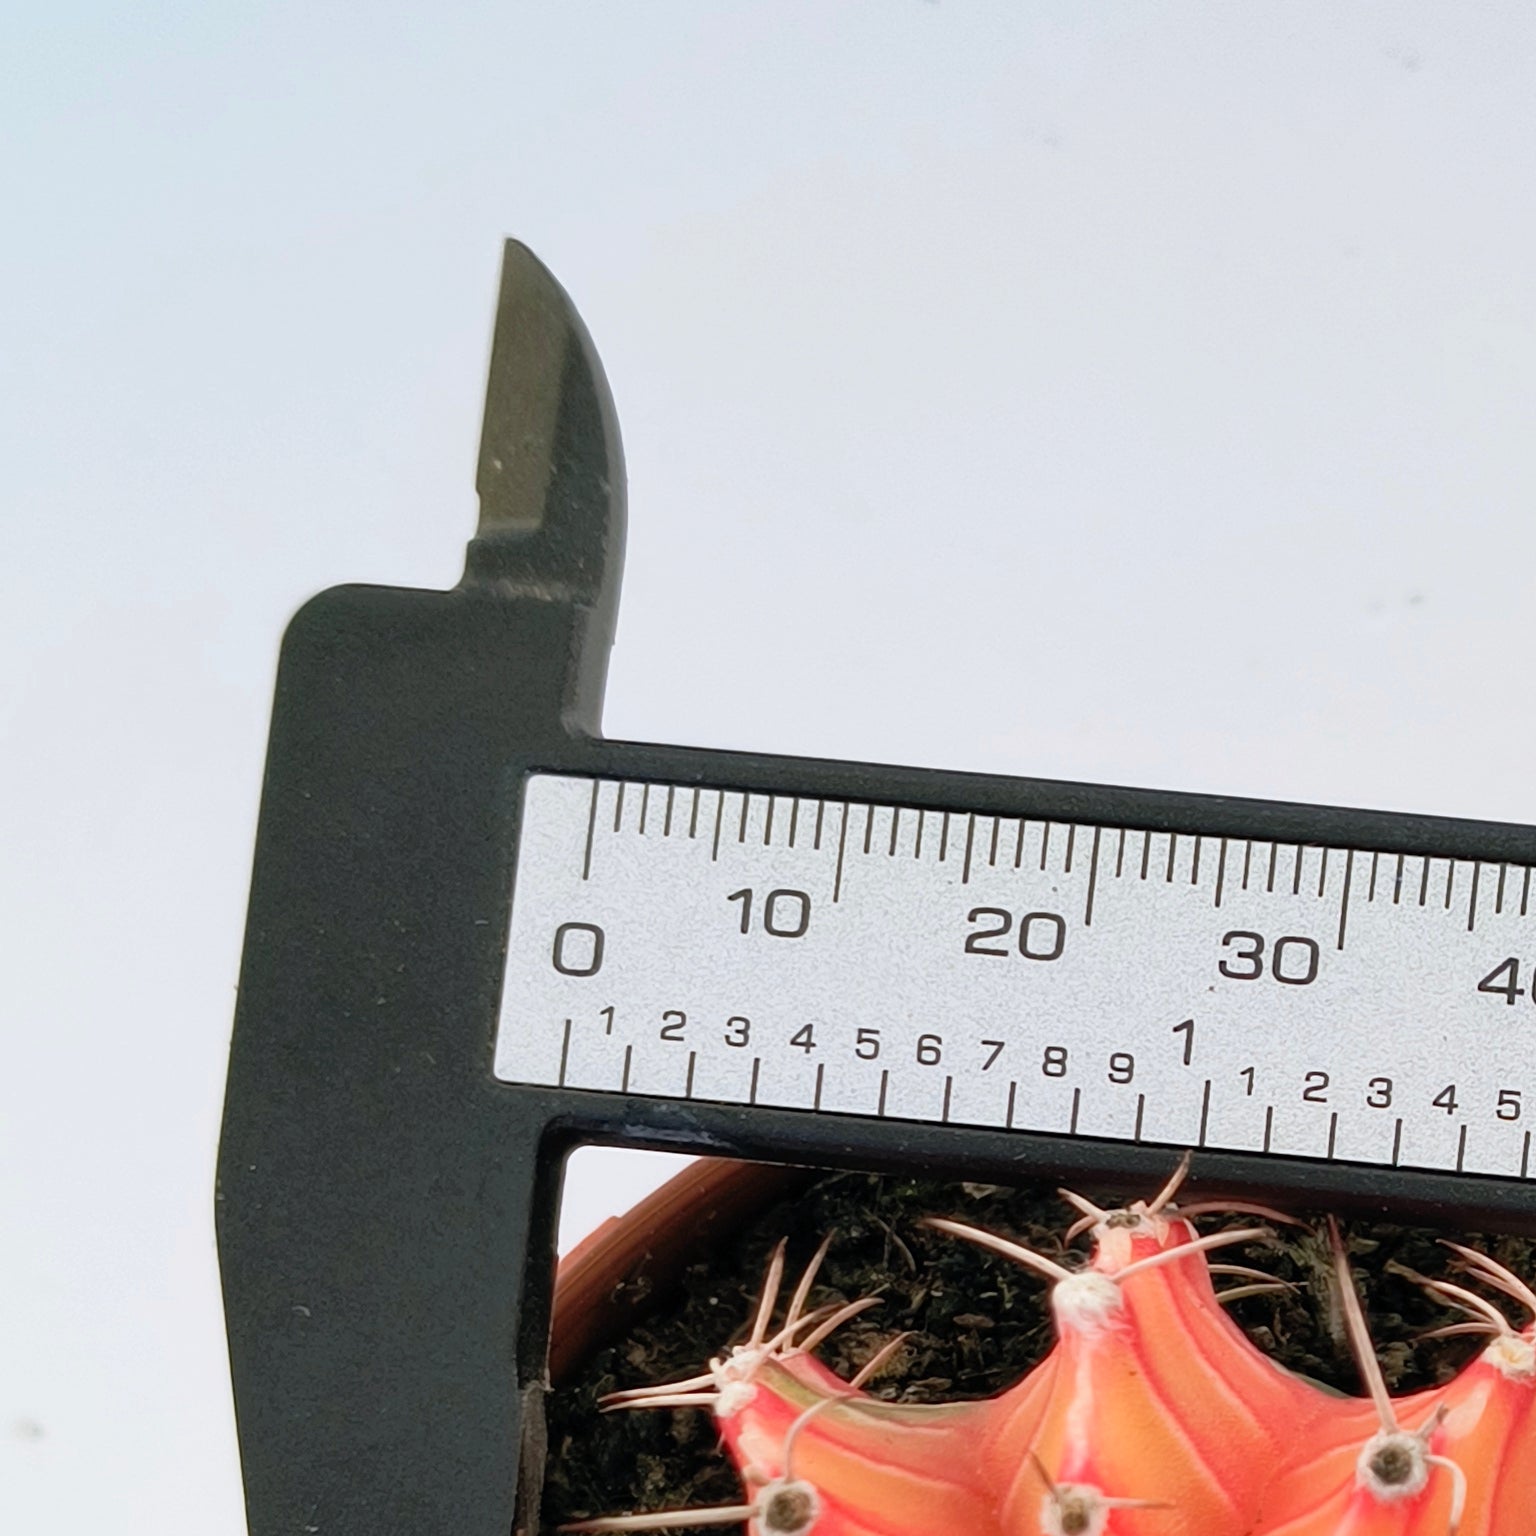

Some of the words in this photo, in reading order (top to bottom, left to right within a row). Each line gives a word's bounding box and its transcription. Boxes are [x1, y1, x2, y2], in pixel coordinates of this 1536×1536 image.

[552, 922, 605, 978] 0
[728, 888, 811, 938] 10
[964, 907, 1066, 961] 20
[1218, 930, 1320, 986] 30
[600, 1006, 615, 1035] 1
[660, 1010, 687, 1042] 2
[724, 1016, 751, 1048] 3
[789, 1023, 817, 1054] 4
[855, 1028, 880, 1060] 5
[916, 1034, 942, 1066] 6
[981, 1039, 1005, 1071] 7
[1042, 1046, 1068, 1078] 8
[1108, 1052, 1135, 1084] 9
[1172, 1019, 1194, 1066] 1
[1240, 1066, 1255, 1096] 1
[1303, 1071, 1330, 1103] 2
[1366, 1077, 1393, 1109] 3
[1432, 1084, 1459, 1116] 4
[1495, 1089, 1522, 1121] 5
